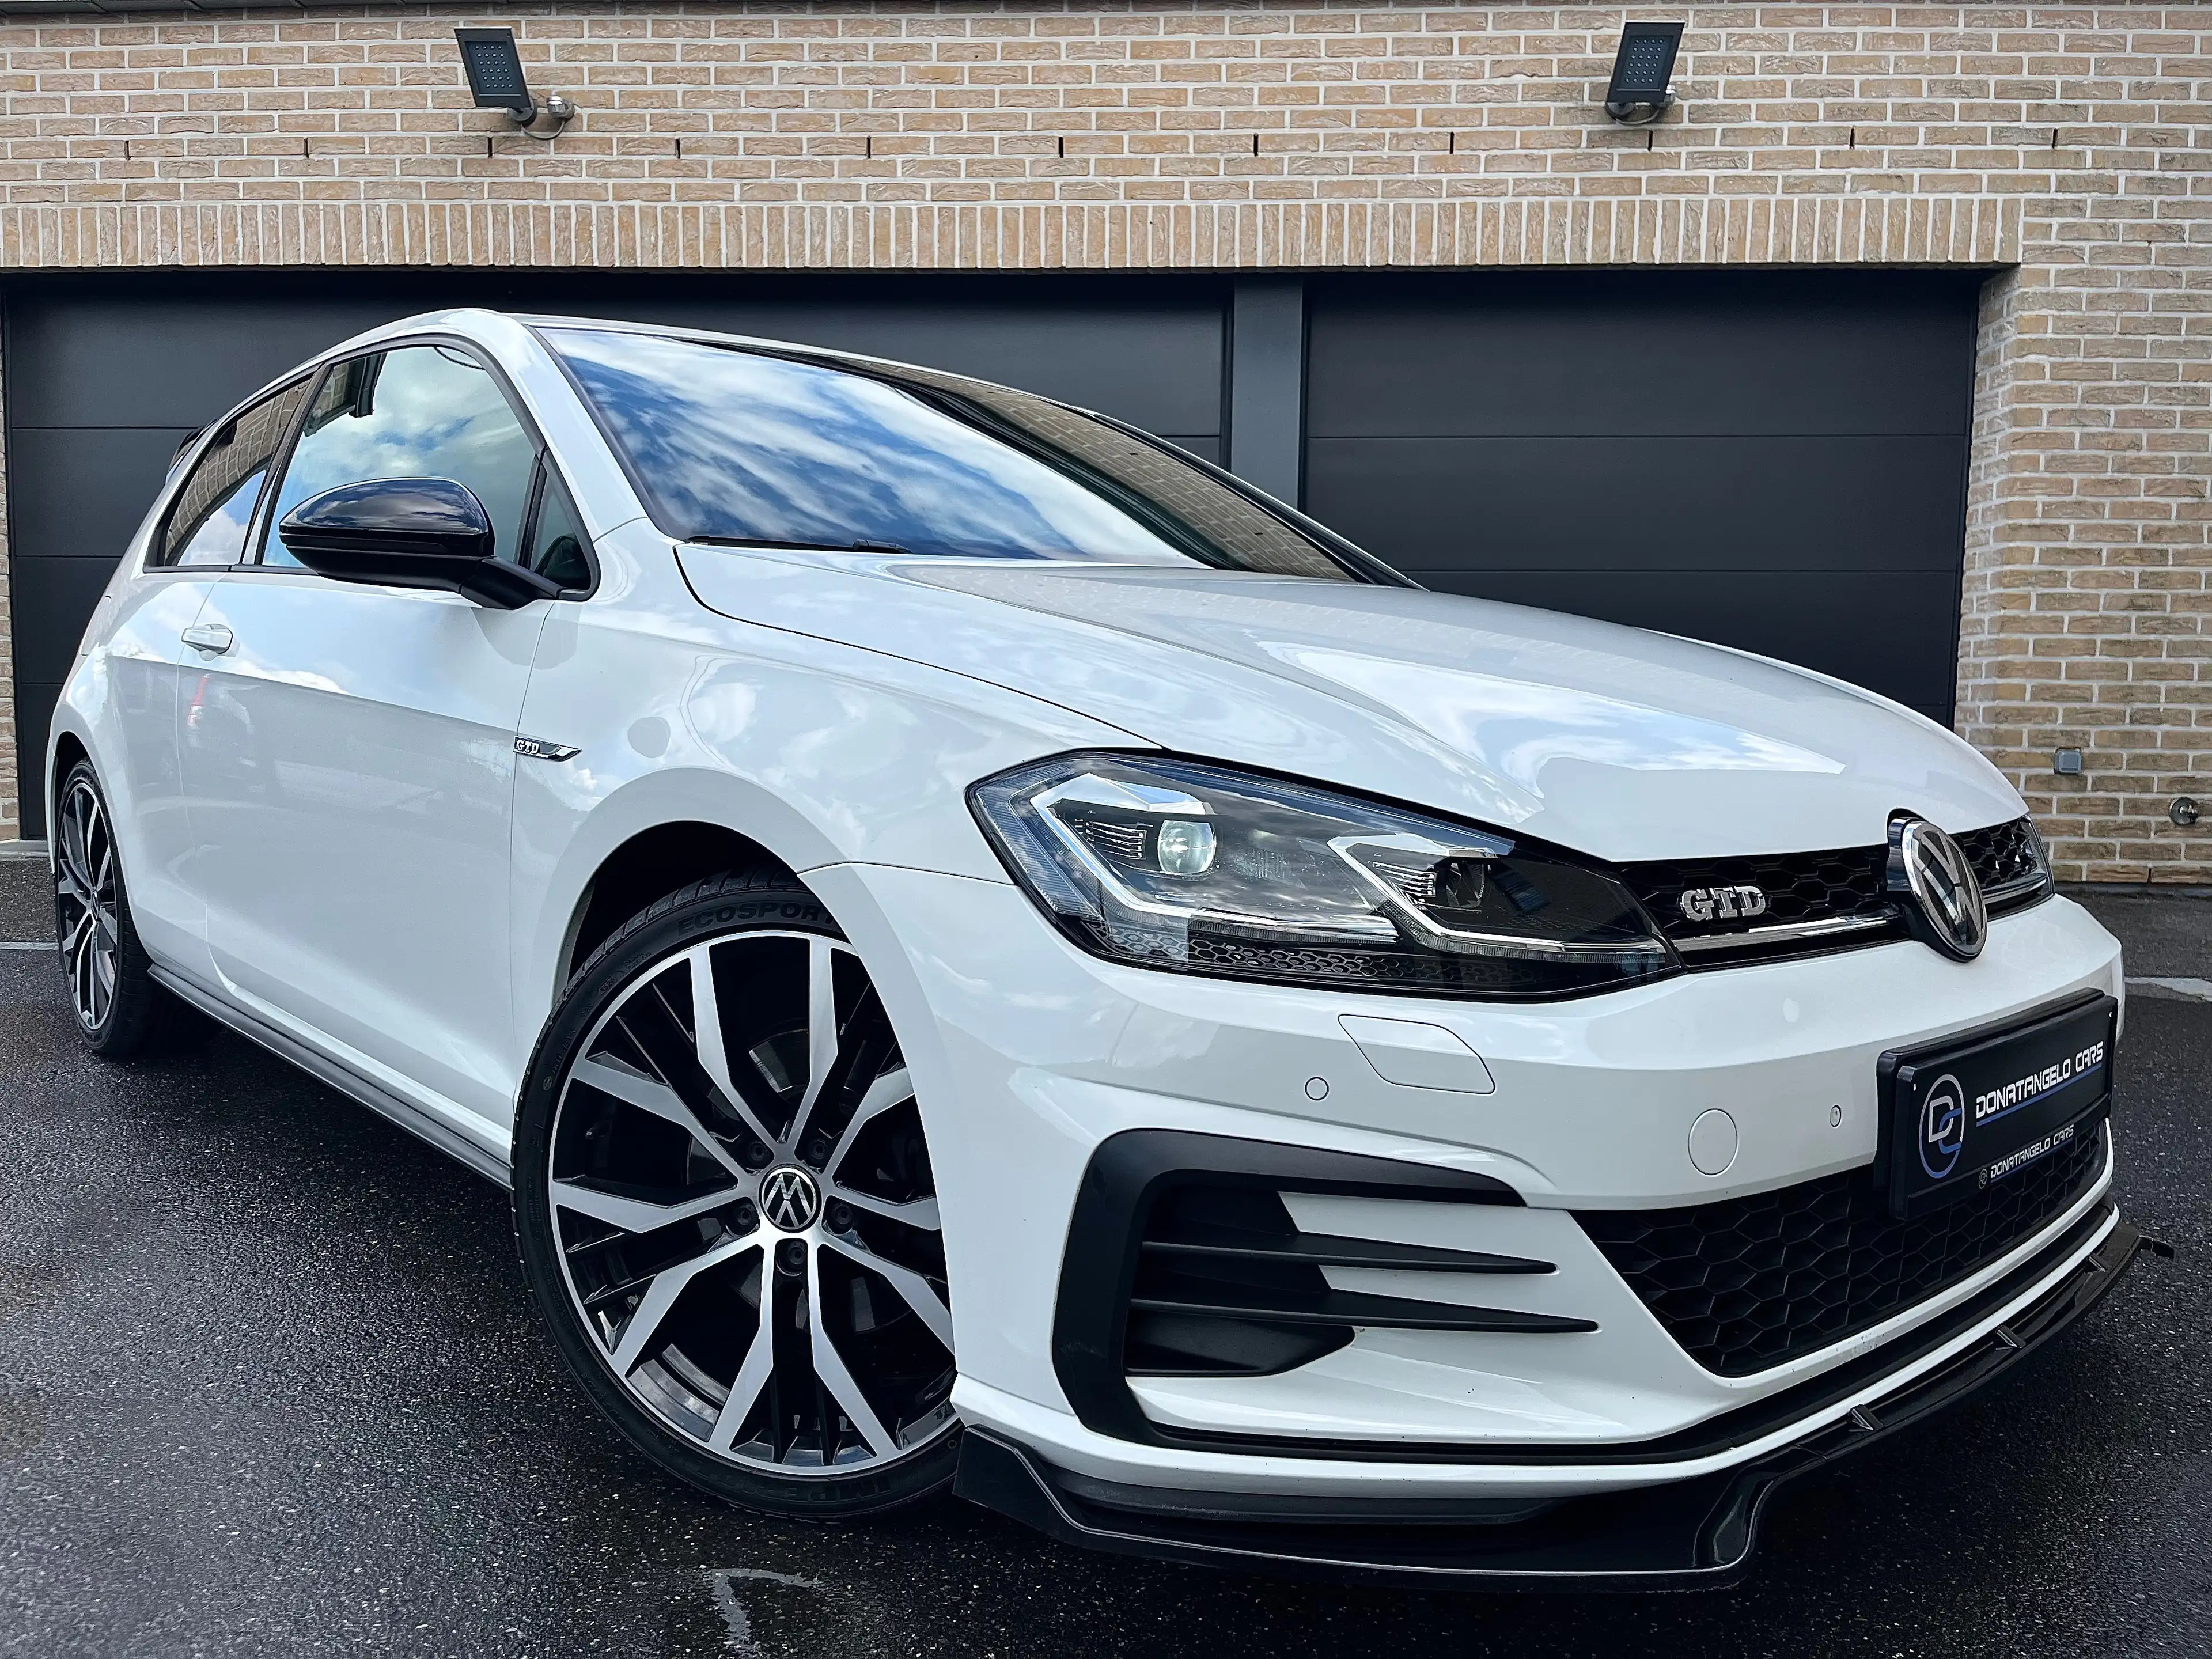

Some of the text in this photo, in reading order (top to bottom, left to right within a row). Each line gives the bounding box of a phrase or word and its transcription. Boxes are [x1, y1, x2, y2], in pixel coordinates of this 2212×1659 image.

[517, 740, 540, 754] GTD
[1680, 885, 1766, 922] GTD
[1976, 1041, 2104, 1119] DONATANGELO CARS
[1990, 1124, 2074, 1179] DONATANGELO CARS
